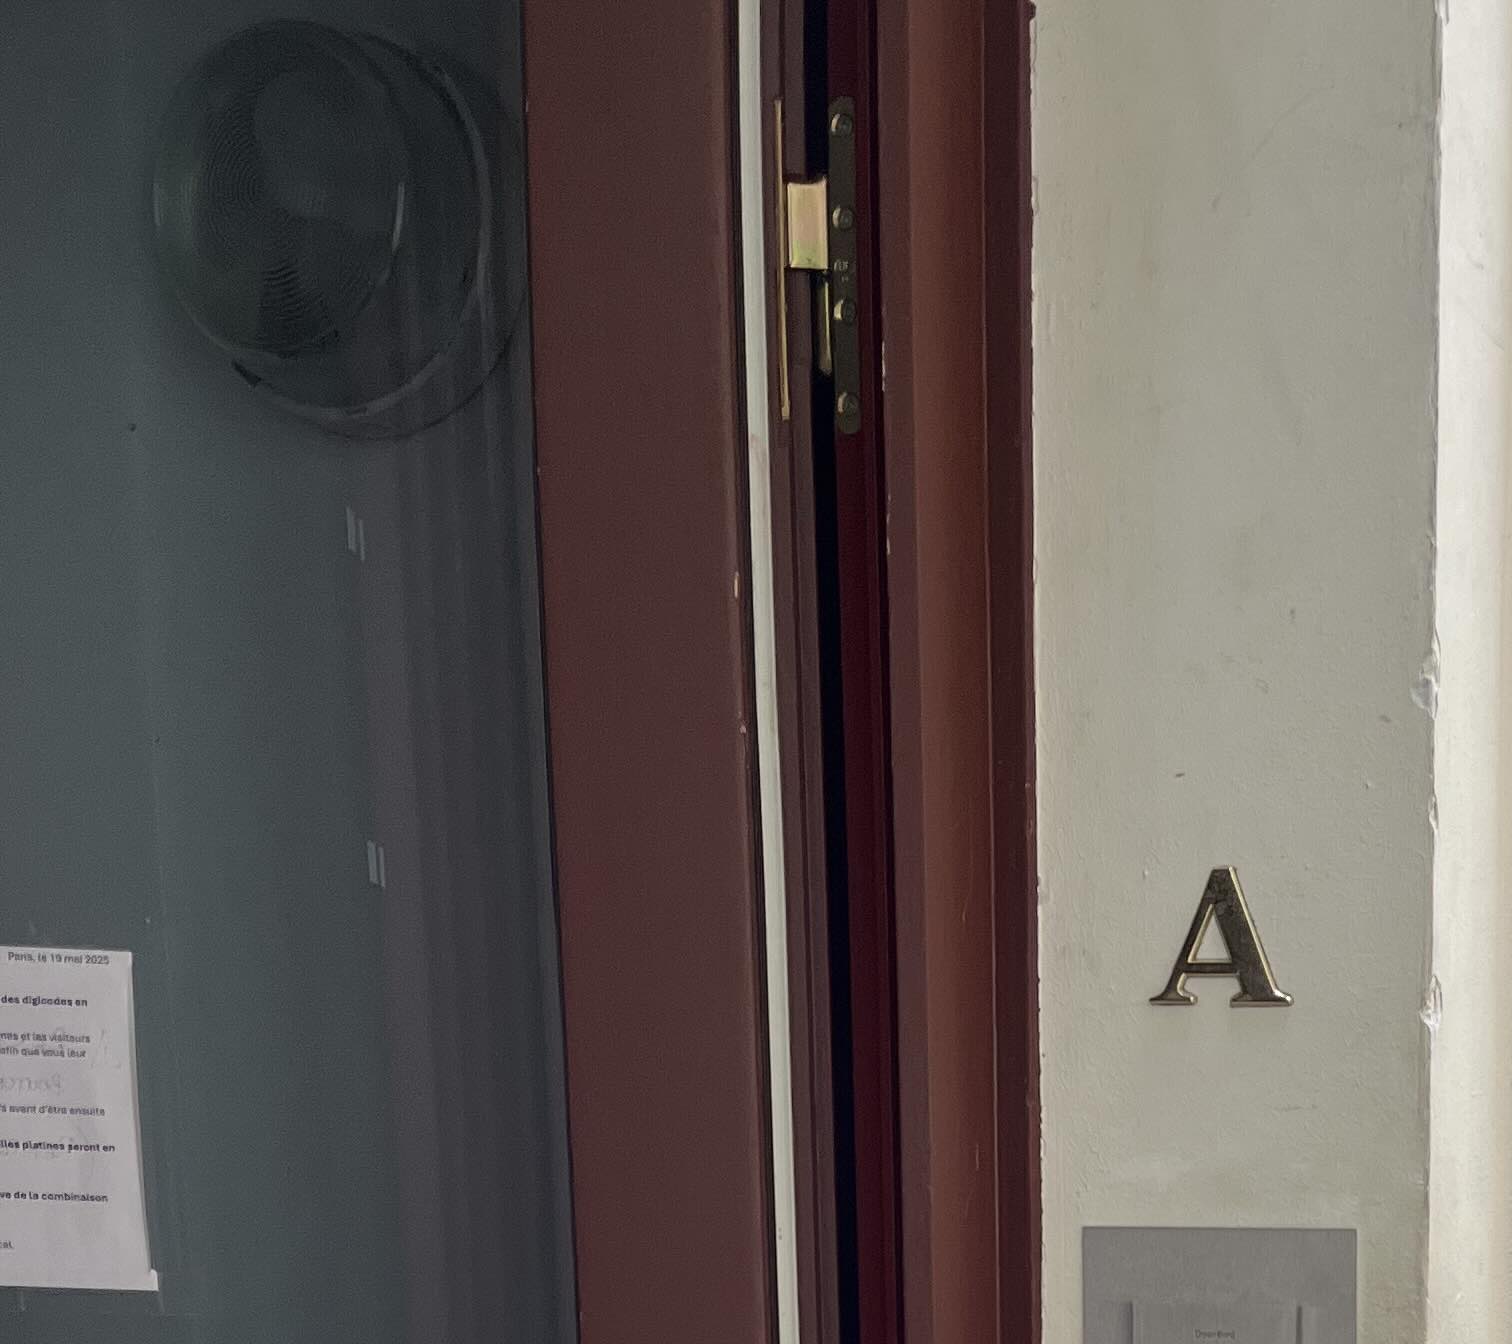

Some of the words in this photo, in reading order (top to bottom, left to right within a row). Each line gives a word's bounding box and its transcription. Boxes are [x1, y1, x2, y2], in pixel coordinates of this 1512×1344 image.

[1149, 864, 1294, 1008] A
[8, 951, 34, 963] Paris,
[38, 952, 47, 963] le
[64, 954, 83, 964] mai
[85, 954, 110, 965] 2025
[1, 995, 20, 1004] des
[75, 998, 88, 1007] en
[21, 1032, 30, 1042] et
[32, 1032, 47, 1042] les
[21, 1047, 40, 1058] que
[22, 1140, 65, 1152] platines
[67, 1143, 100, 1153] seront
[102, 1145, 116, 1153] en
[14, 1191, 27, 1200] de
[29, 1191, 39, 1200] la
[41, 1192, 109, 1203] combinaison
